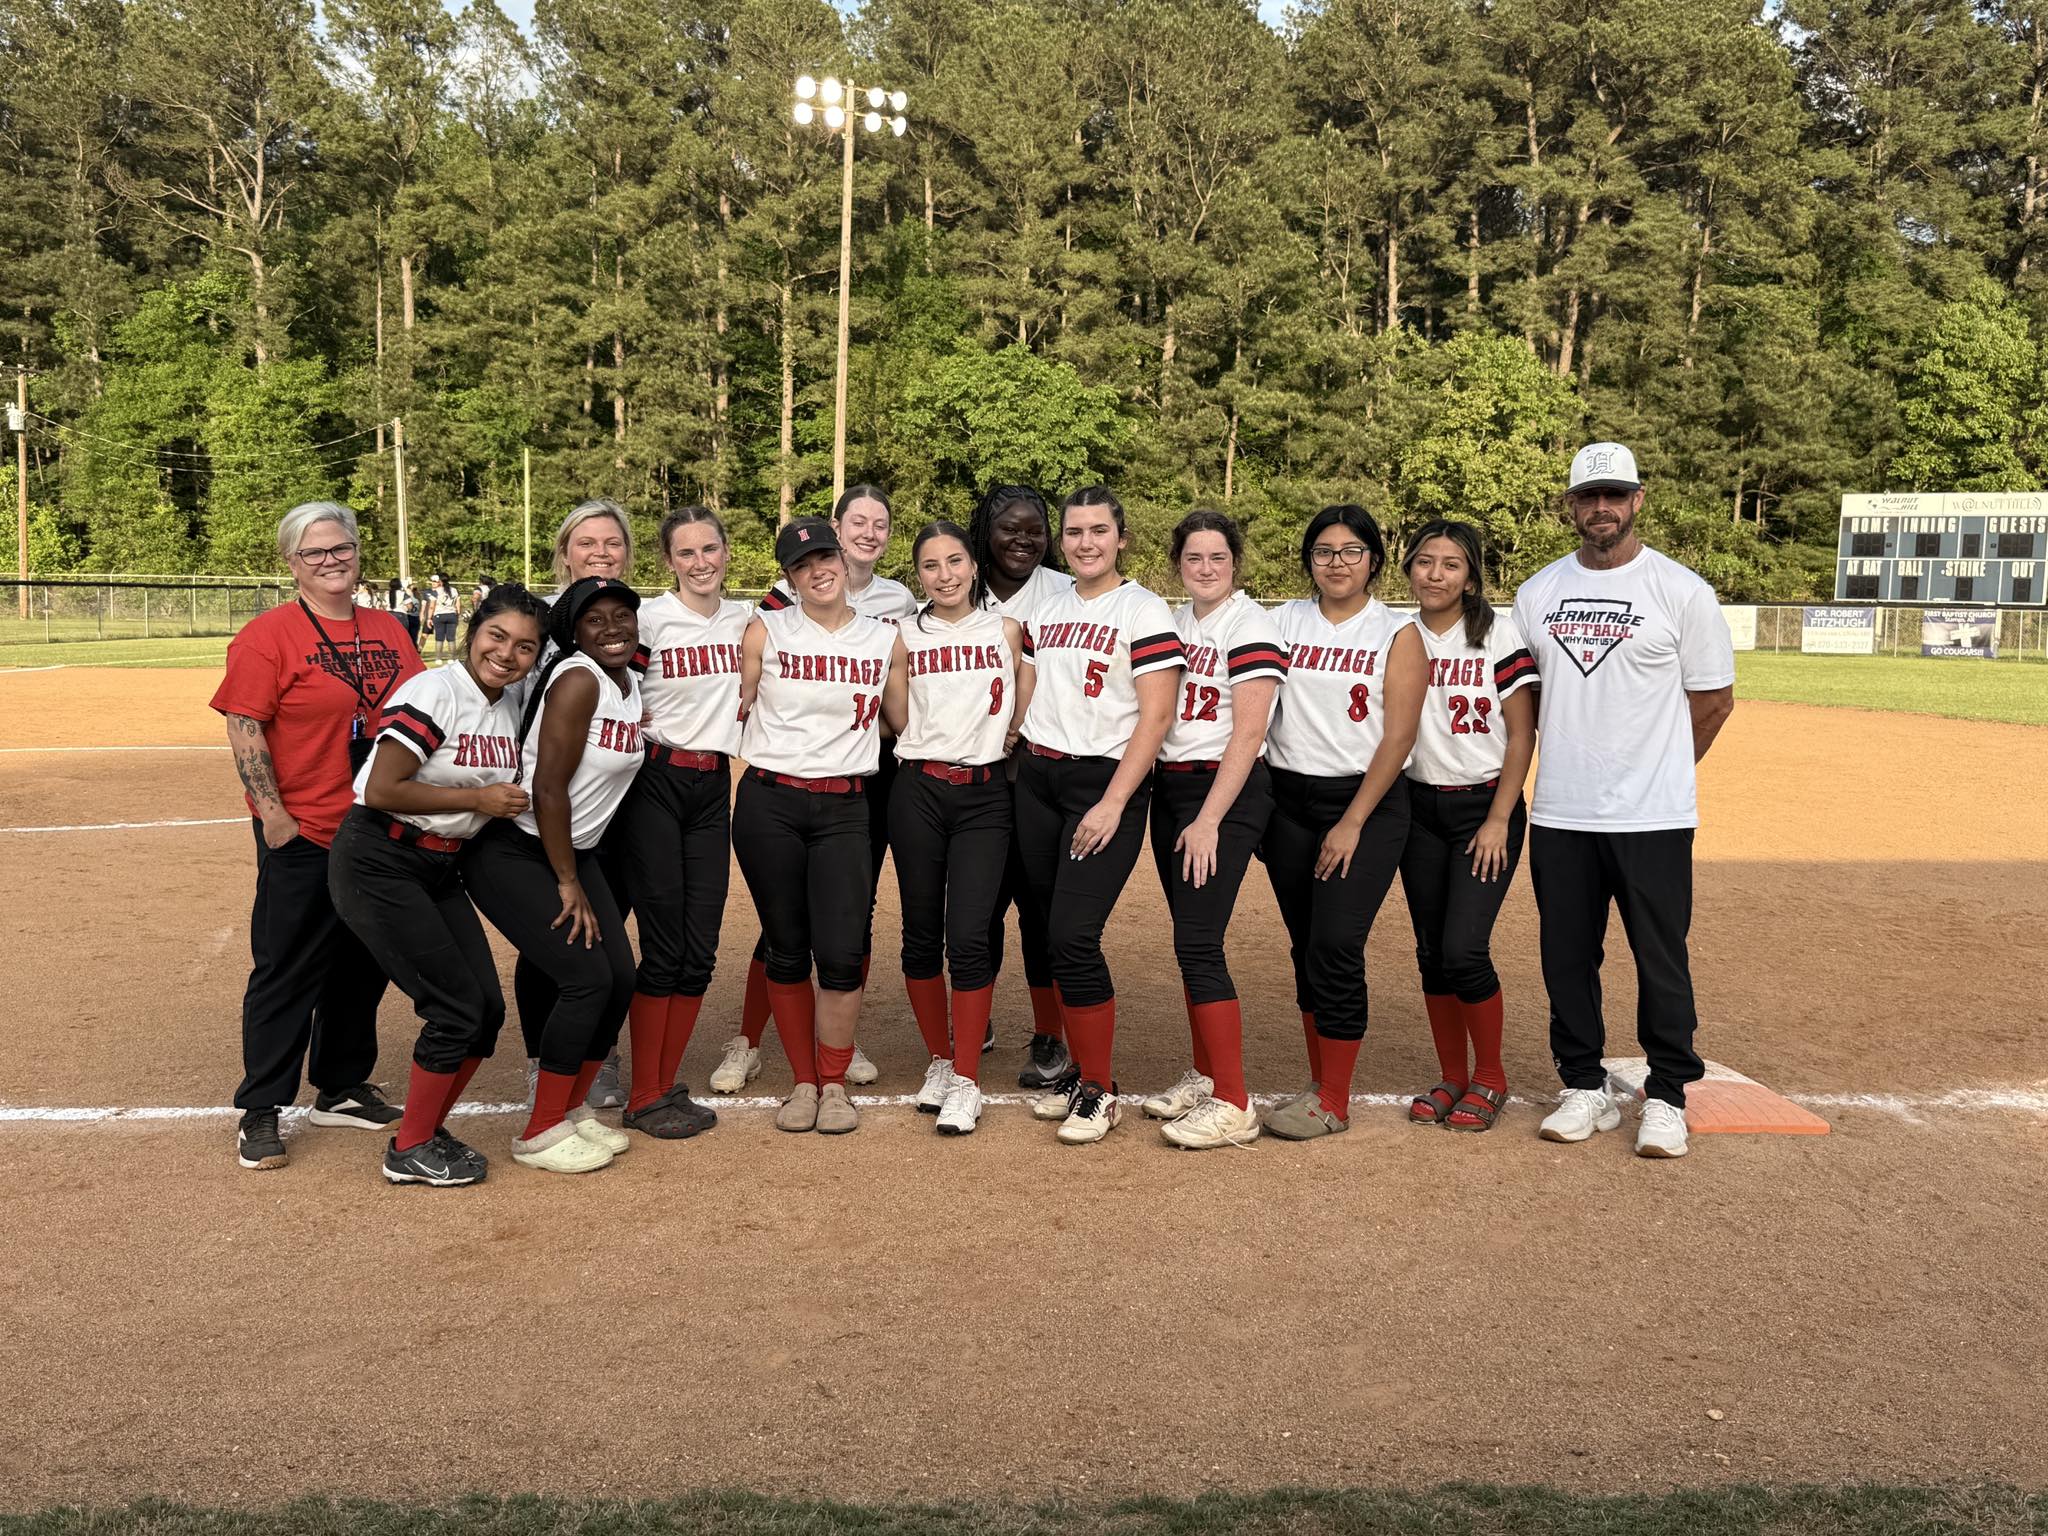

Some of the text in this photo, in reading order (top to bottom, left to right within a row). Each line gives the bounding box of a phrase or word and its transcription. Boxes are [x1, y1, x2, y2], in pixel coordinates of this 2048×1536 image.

[1851, 517, 1890, 533] HOME
[1903, 517, 1957, 533] INNING
[1989, 517, 2047, 534] GUESTS
[1846, 560, 1882, 577] AT BAT
[1897, 561, 1924, 577] BALL
[1946, 561, 1986, 577] STRIKE
[2011, 562, 2036, 578] OUT
[1542, 610, 1645, 627] HERMITAGE
[1814, 609, 1864, 618] DR. ROBERT
[1548, 623, 1633, 639] SOFTBALL
[1811, 618, 1866, 628] FITZHUGH
[1036, 622, 1119, 656] HERMITAGE
[1562, 635, 1614, 646] WHY NOT US?
[1288, 643, 1378, 676] ERMITAGE
[1582, 650, 1594, 662] H
[777, 650, 883, 686] HERMITAGE
[1084, 658, 1109, 699] 5
[1181, 681, 1220, 722] 12
[1347, 683, 1370, 723] 8
[1448, 694, 1491, 735] 23
[453, 733, 520, 770] HERMITA
